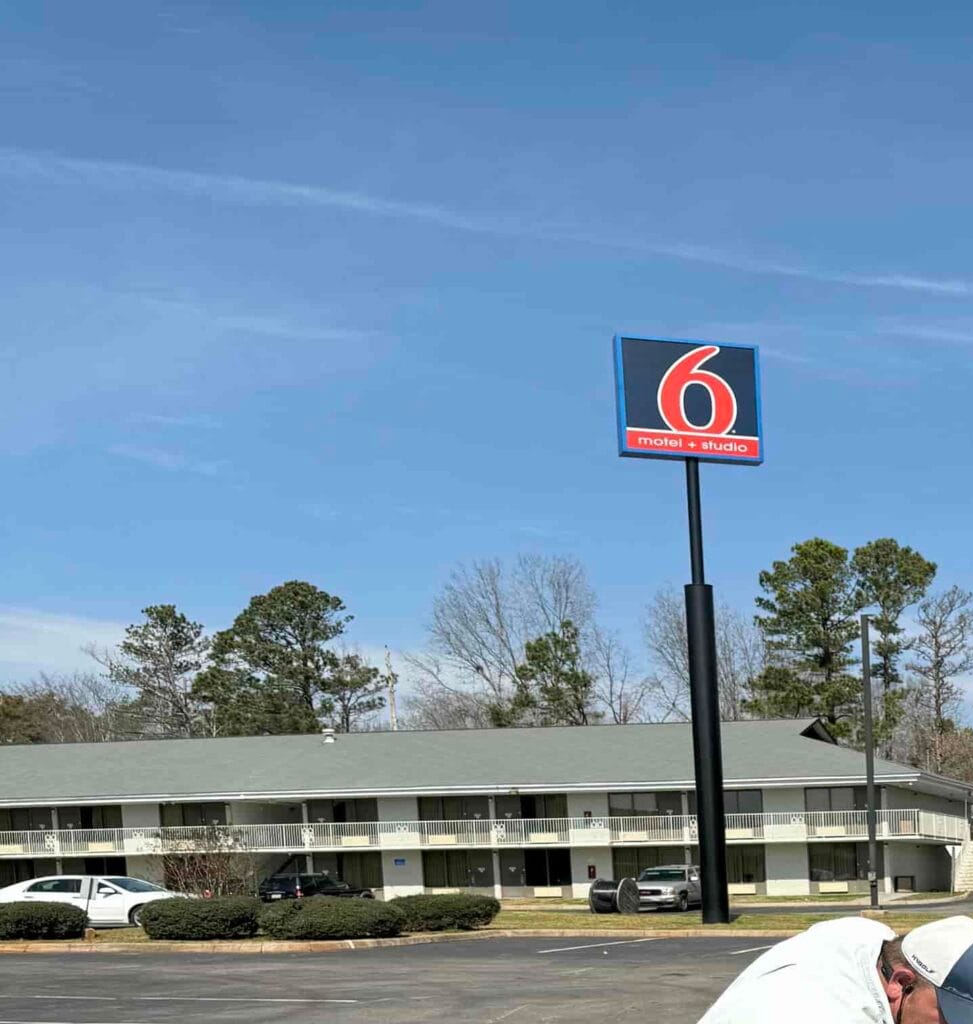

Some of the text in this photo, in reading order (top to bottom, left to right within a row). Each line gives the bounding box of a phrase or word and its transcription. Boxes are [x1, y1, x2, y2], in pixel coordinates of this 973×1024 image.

[657, 345, 737, 436] 6
[638, 436, 748, 453] motel + studio
